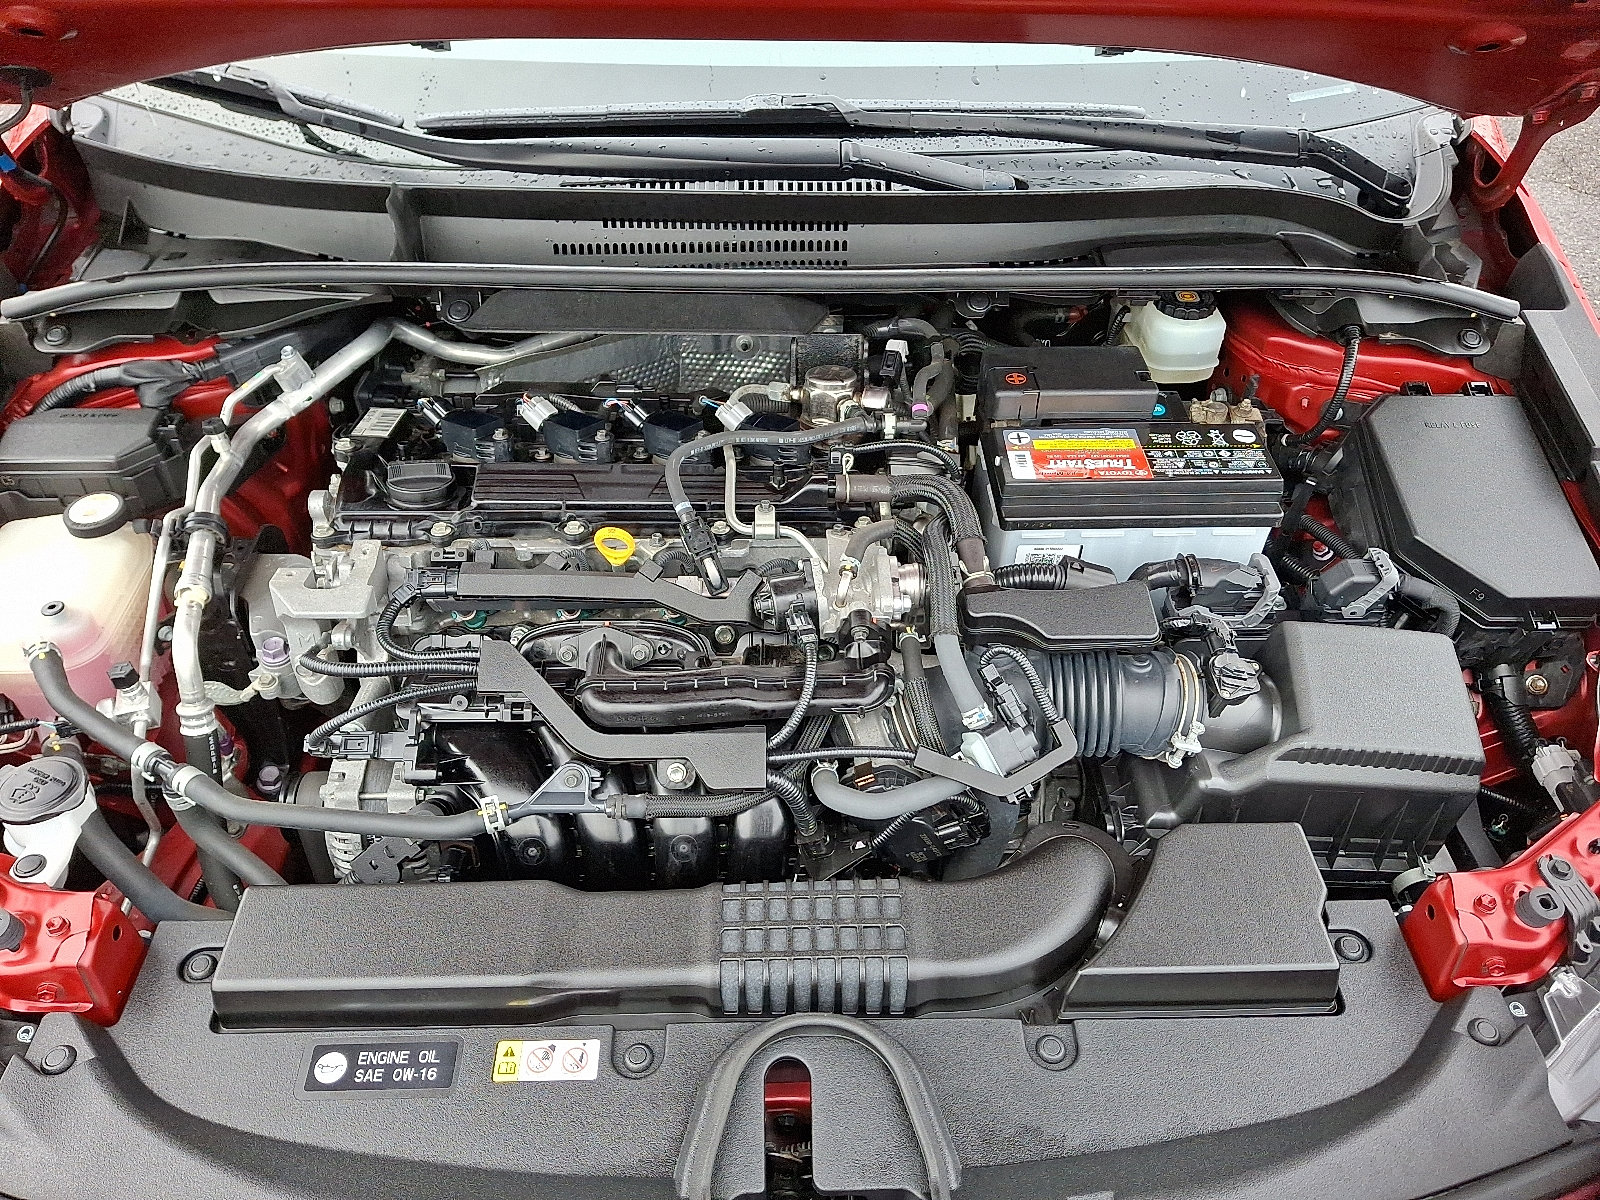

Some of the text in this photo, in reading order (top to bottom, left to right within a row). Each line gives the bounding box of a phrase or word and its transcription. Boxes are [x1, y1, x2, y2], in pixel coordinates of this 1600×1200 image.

[357, 1050, 441, 1065] ENGINE OIL
[353, 1067, 438, 1083] SAE 0W-16
